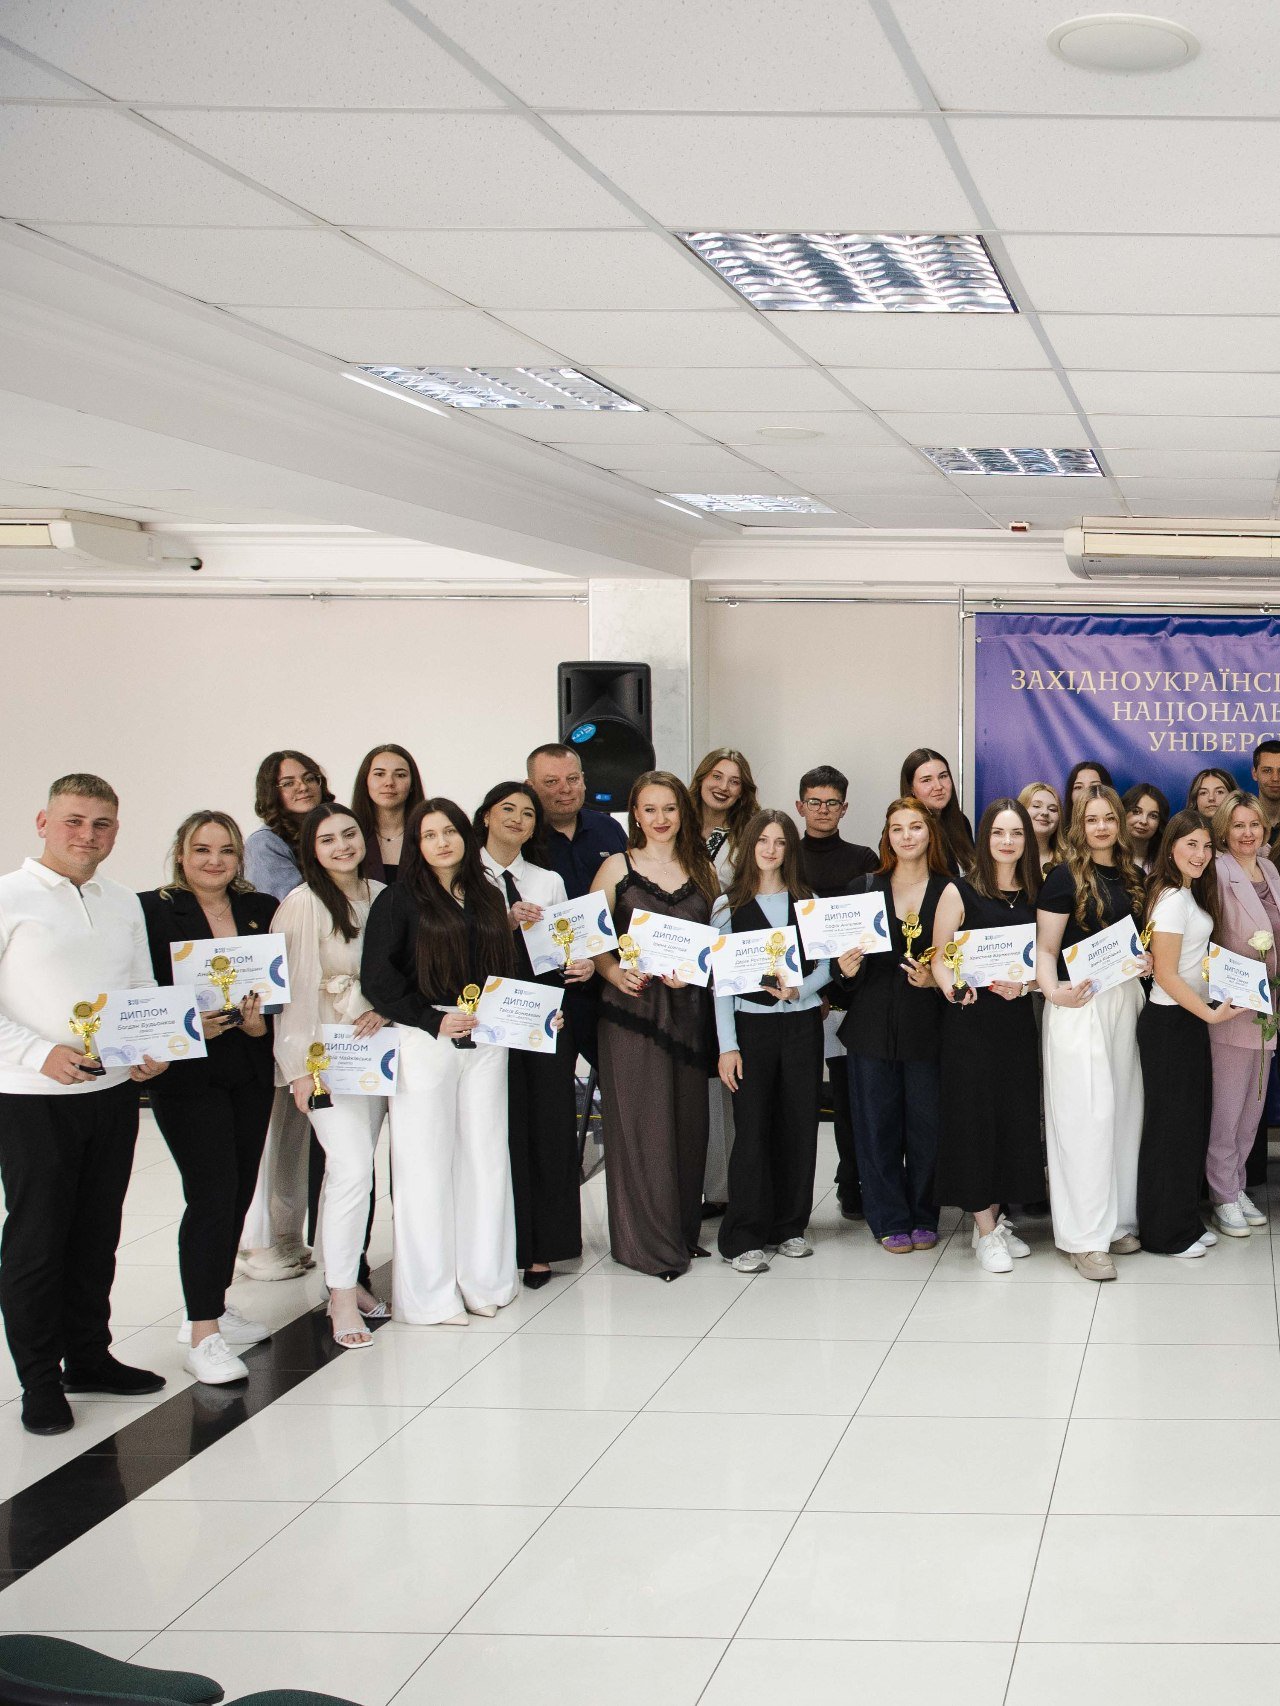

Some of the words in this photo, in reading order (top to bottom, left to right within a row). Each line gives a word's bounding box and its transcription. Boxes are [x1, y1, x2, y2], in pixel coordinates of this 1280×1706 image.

[824, 911, 861, 921] ДИПЛОМ
[652, 930, 691, 944] ДИПЛОМ
[735, 946, 767, 957] ДИПЛО
[976, 942, 1013, 953] ДИПЛОМ
[1088, 940, 1119, 962] ДИПЛОМ
[204, 955, 254, 968] ДЛОМ
[502, 996, 541, 1009] ДИПЛОМ
[120, 1007, 169, 1021] ДИПЛОМ
[324, 1042, 369, 1052] ДИПЛОМ
